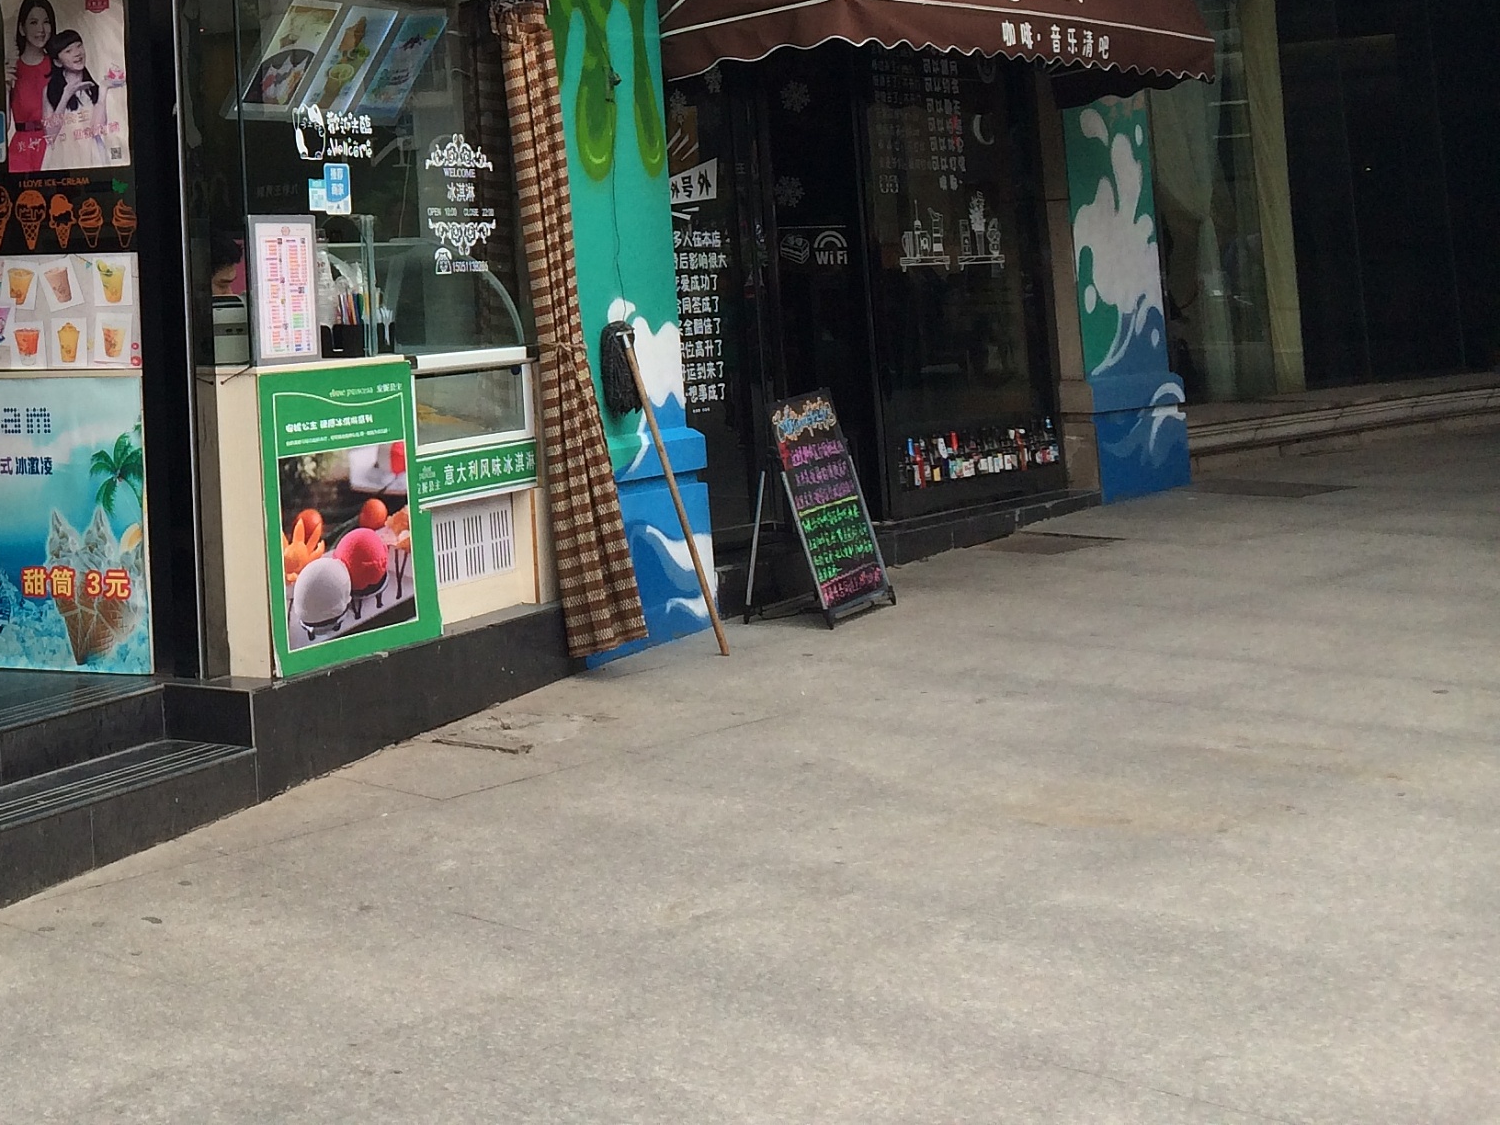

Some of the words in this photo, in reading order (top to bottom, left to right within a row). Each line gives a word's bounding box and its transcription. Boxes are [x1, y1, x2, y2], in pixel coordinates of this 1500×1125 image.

[443, 168, 476, 178] WELCOME
[23, 179, 43, 188] LOVE
[21, 567, 75, 597] 甜筒
[86, 569, 131, 598] 3元
